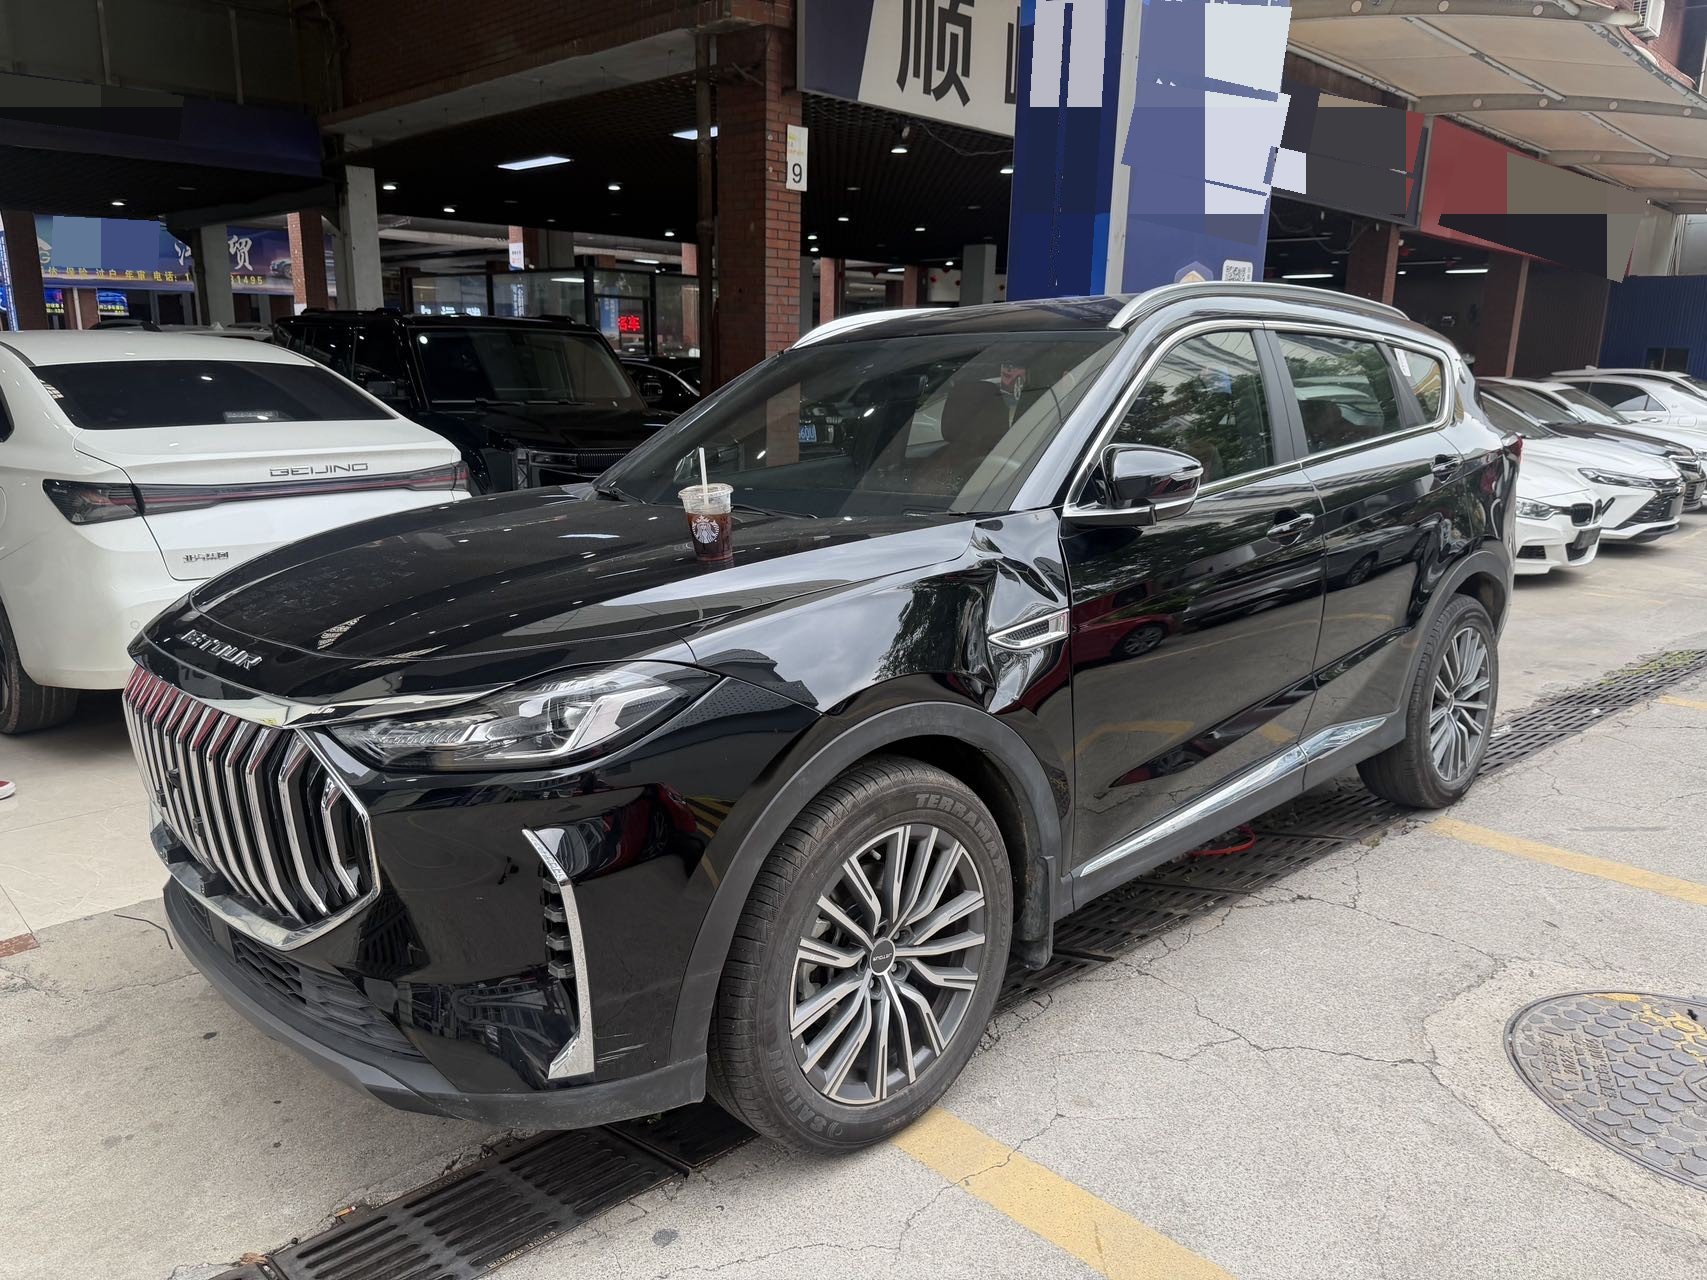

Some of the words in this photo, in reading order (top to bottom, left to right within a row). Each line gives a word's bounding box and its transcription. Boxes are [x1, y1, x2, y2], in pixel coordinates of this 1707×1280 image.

[792, 162, 803, 184] 9
[180, 628, 263, 671] JETOUR
[915, 793, 1005, 874] TERRAMAX
